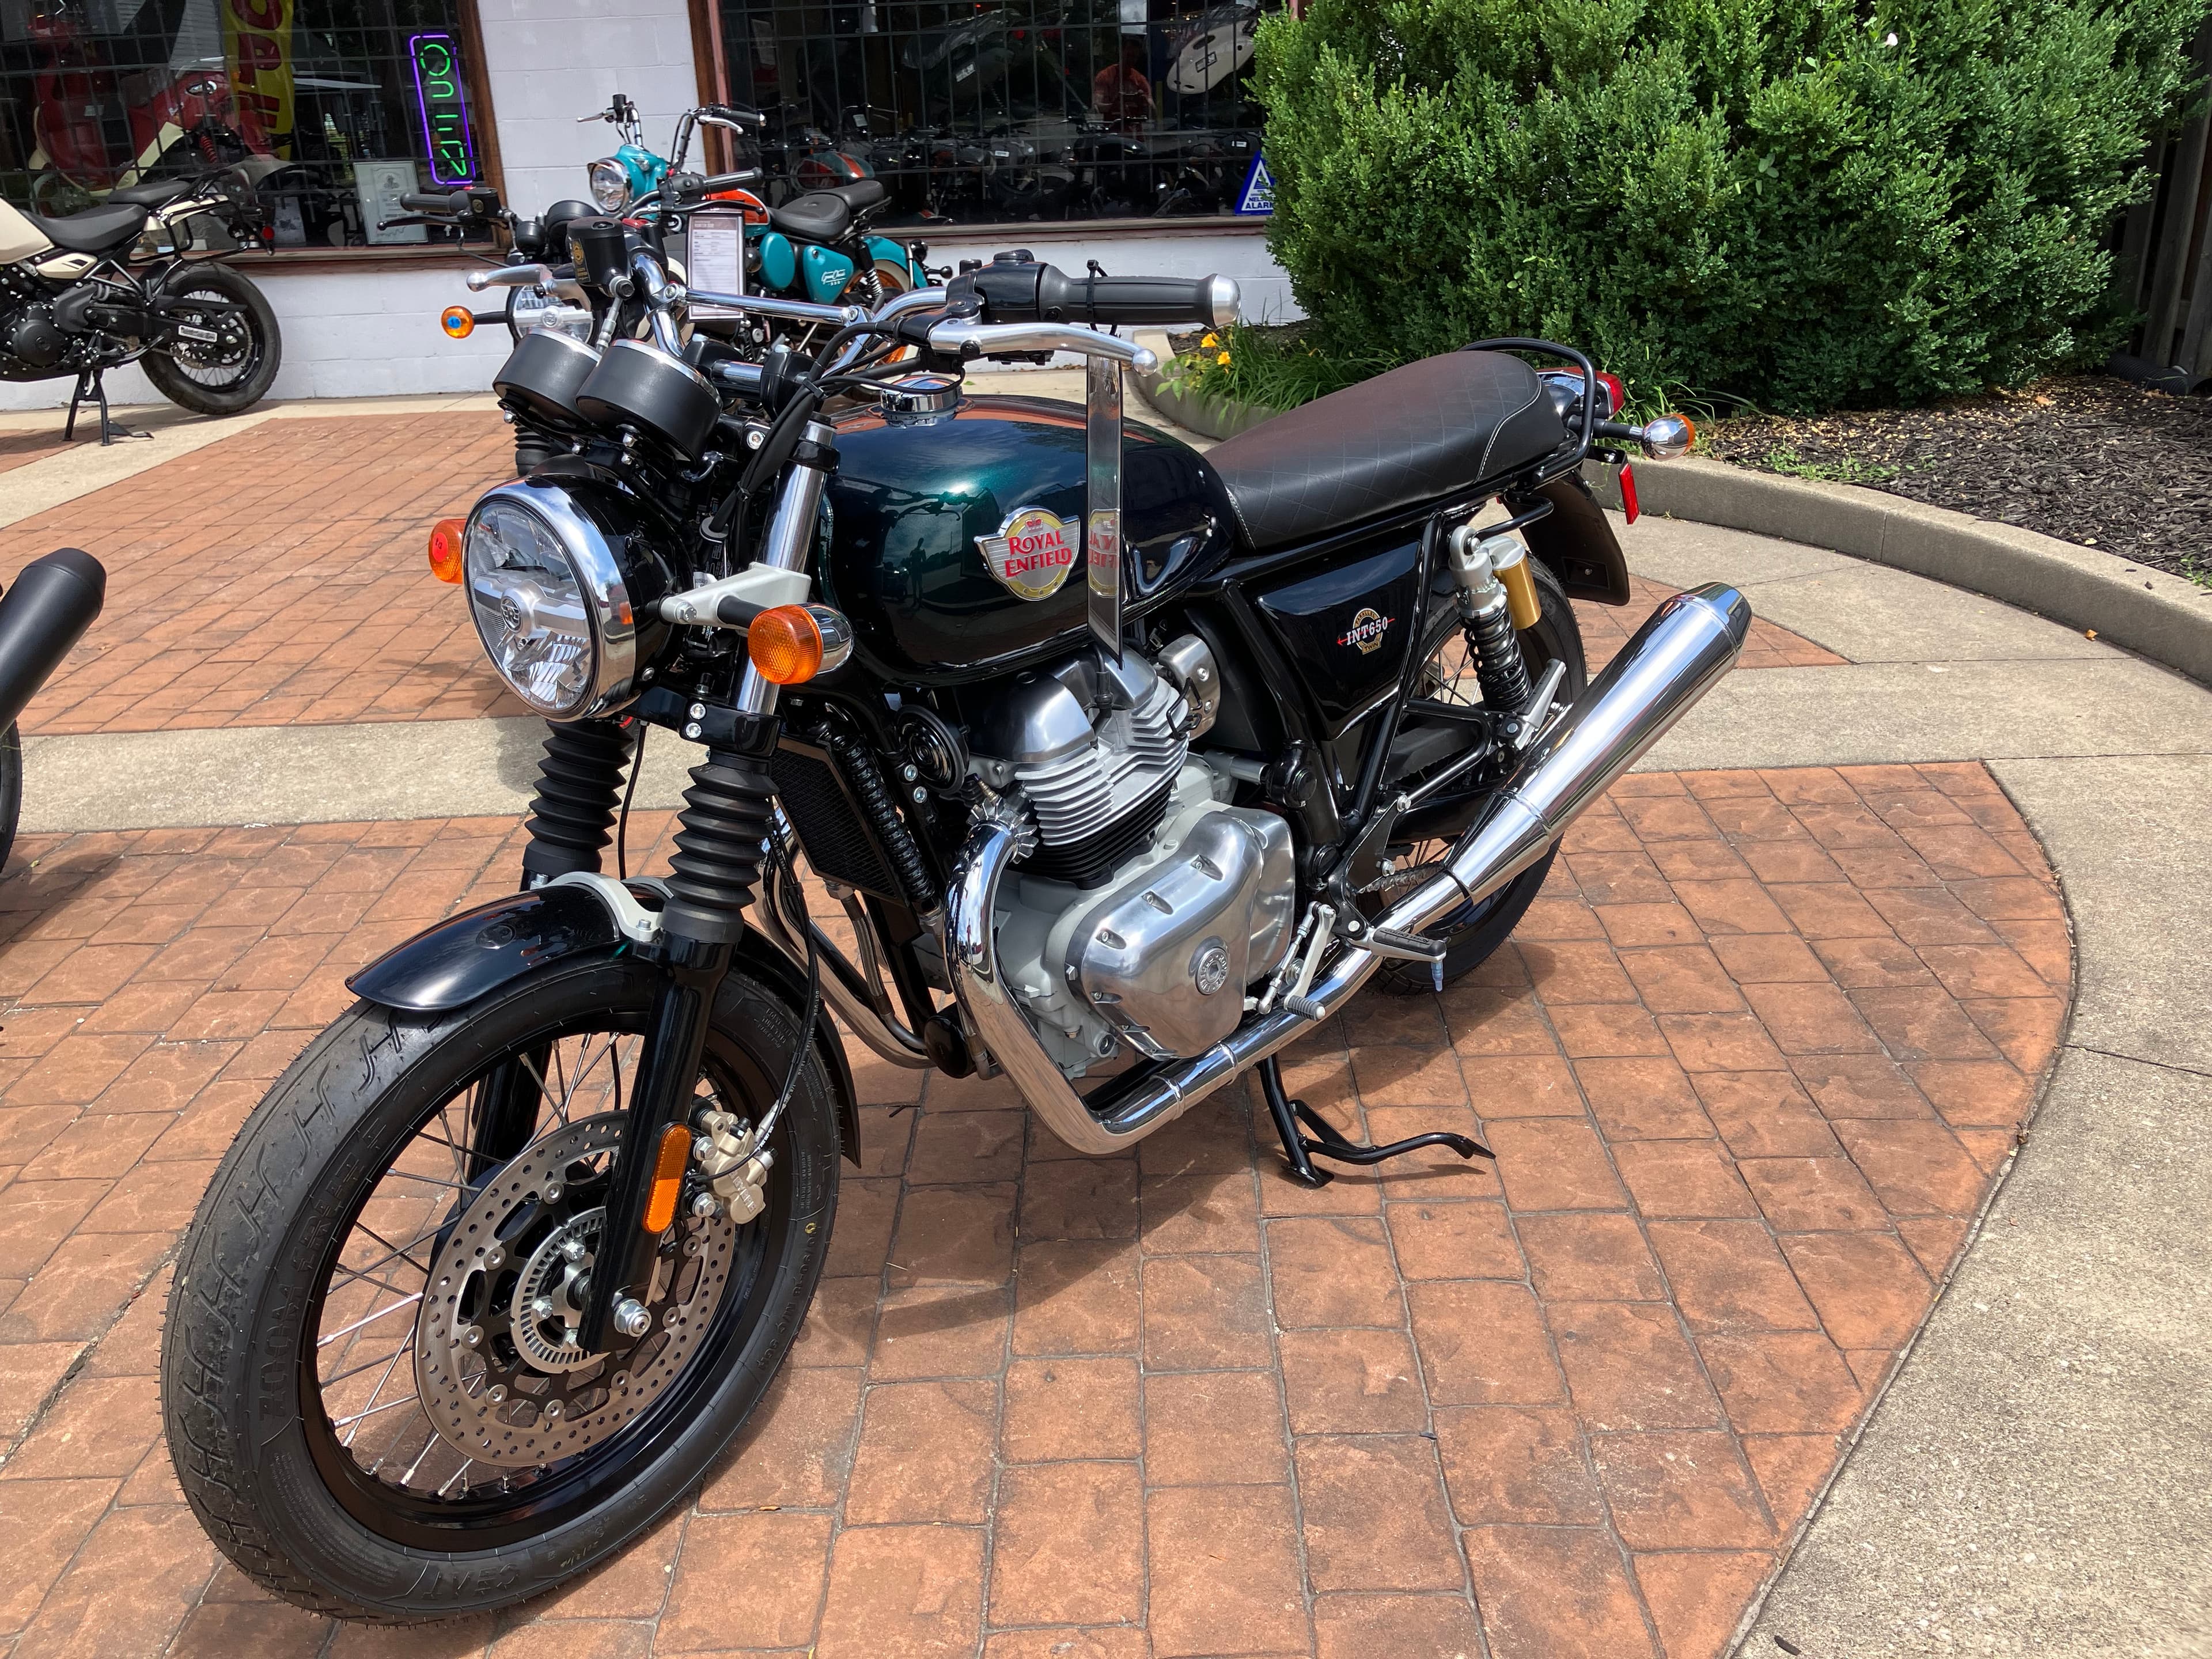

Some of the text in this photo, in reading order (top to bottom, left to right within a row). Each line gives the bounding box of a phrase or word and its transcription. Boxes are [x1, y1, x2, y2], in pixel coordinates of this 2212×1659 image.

[1009, 529, 1065, 555] ROYAL
[1004, 547, 1072, 578] ENFIELD
[1355, 610, 1376, 624] PARALLEL
[1346, 616, 1388, 646] INT650
[1364, 641, 1378, 652] TWIN
